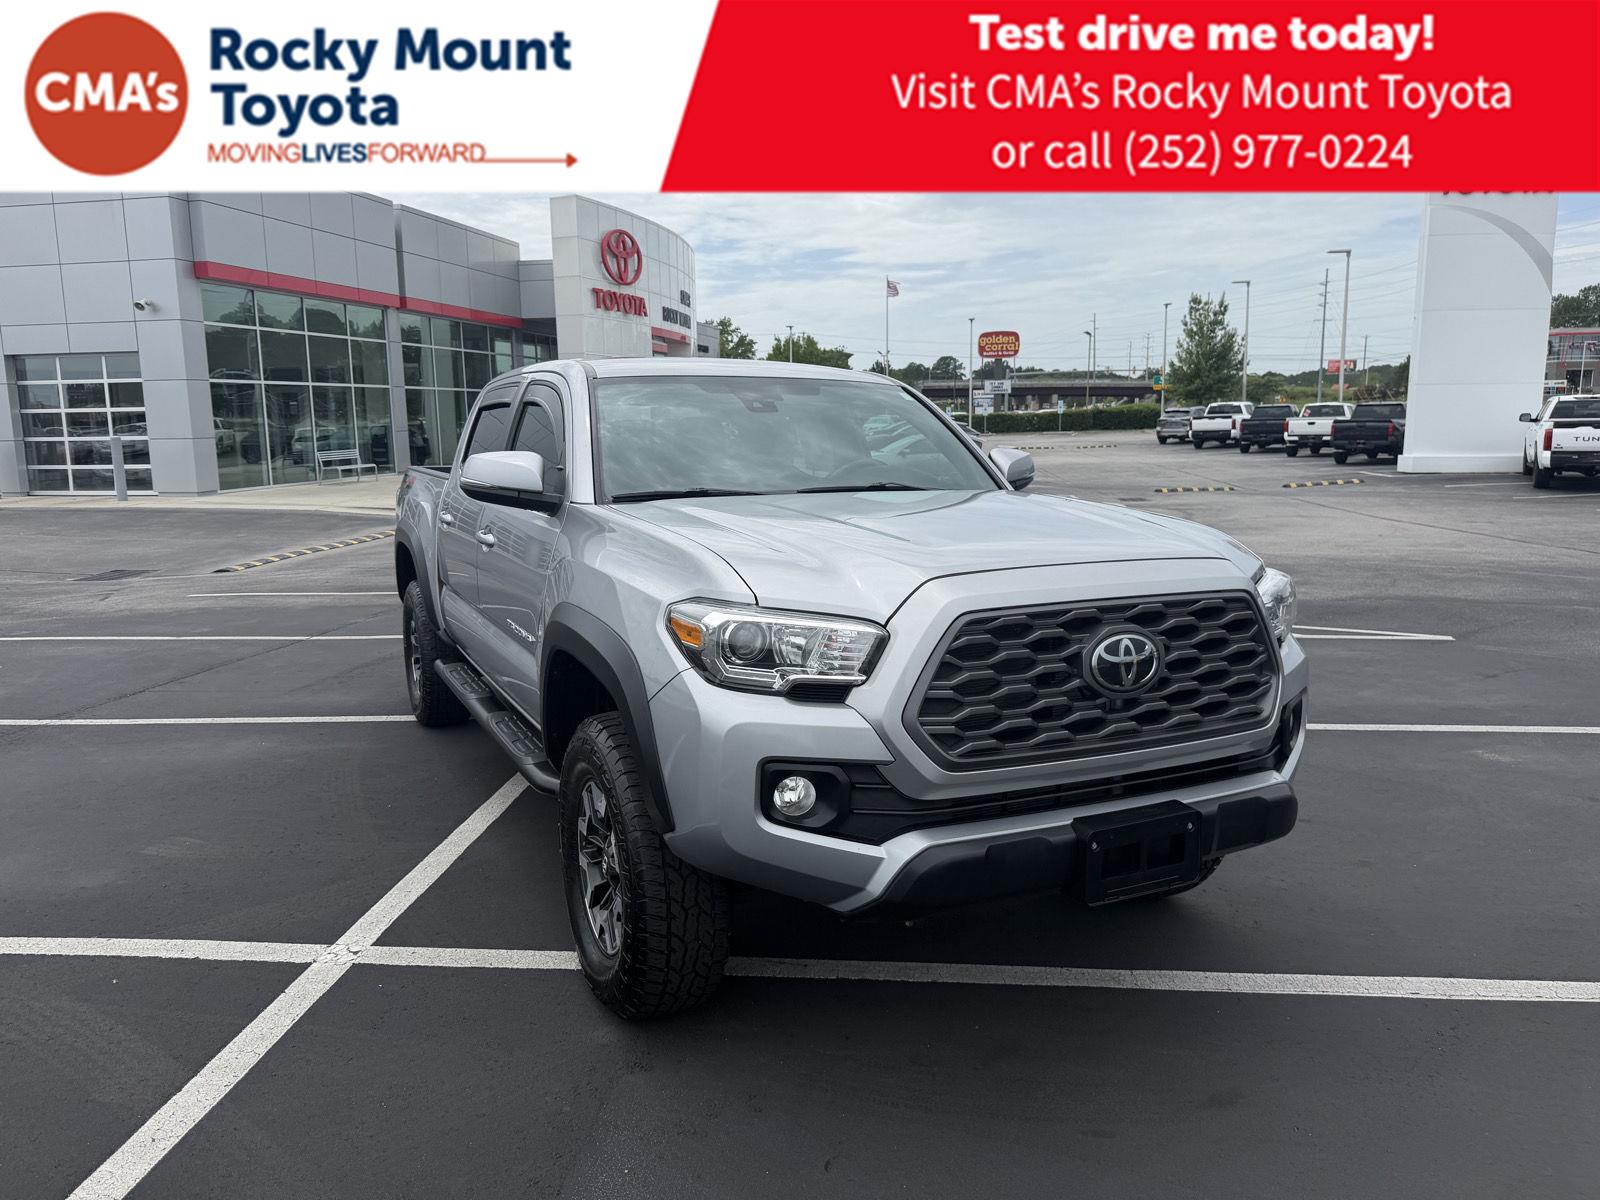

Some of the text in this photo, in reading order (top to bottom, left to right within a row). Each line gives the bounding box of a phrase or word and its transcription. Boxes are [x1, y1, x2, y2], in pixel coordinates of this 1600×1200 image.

[592, 287, 648, 317] TOYOTA
[979, 335, 1015, 346] golden
[985, 342, 1019, 351] corral
